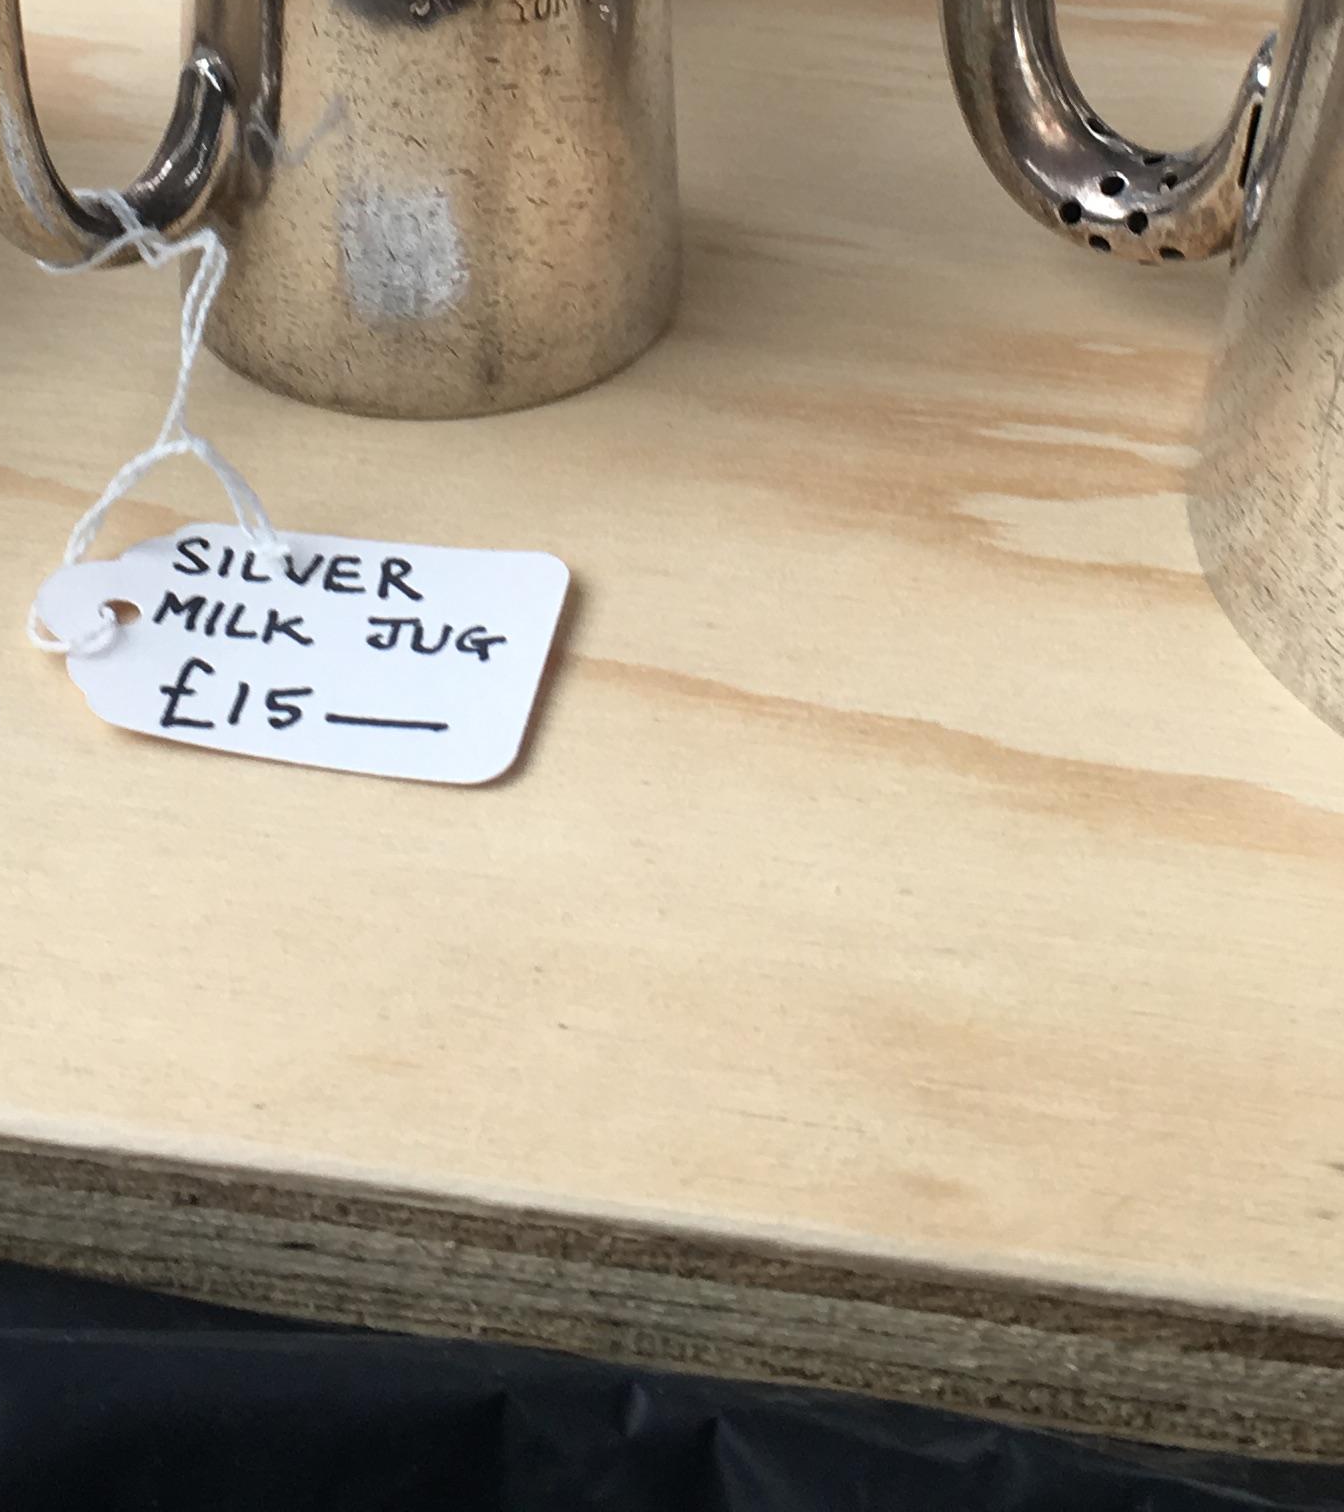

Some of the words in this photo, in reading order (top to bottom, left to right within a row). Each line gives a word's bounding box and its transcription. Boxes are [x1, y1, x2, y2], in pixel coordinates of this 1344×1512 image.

[172, 536, 424, 602] SILVER
[153, 591, 316, 647] MILK
[365, 615, 508, 663] JUG
